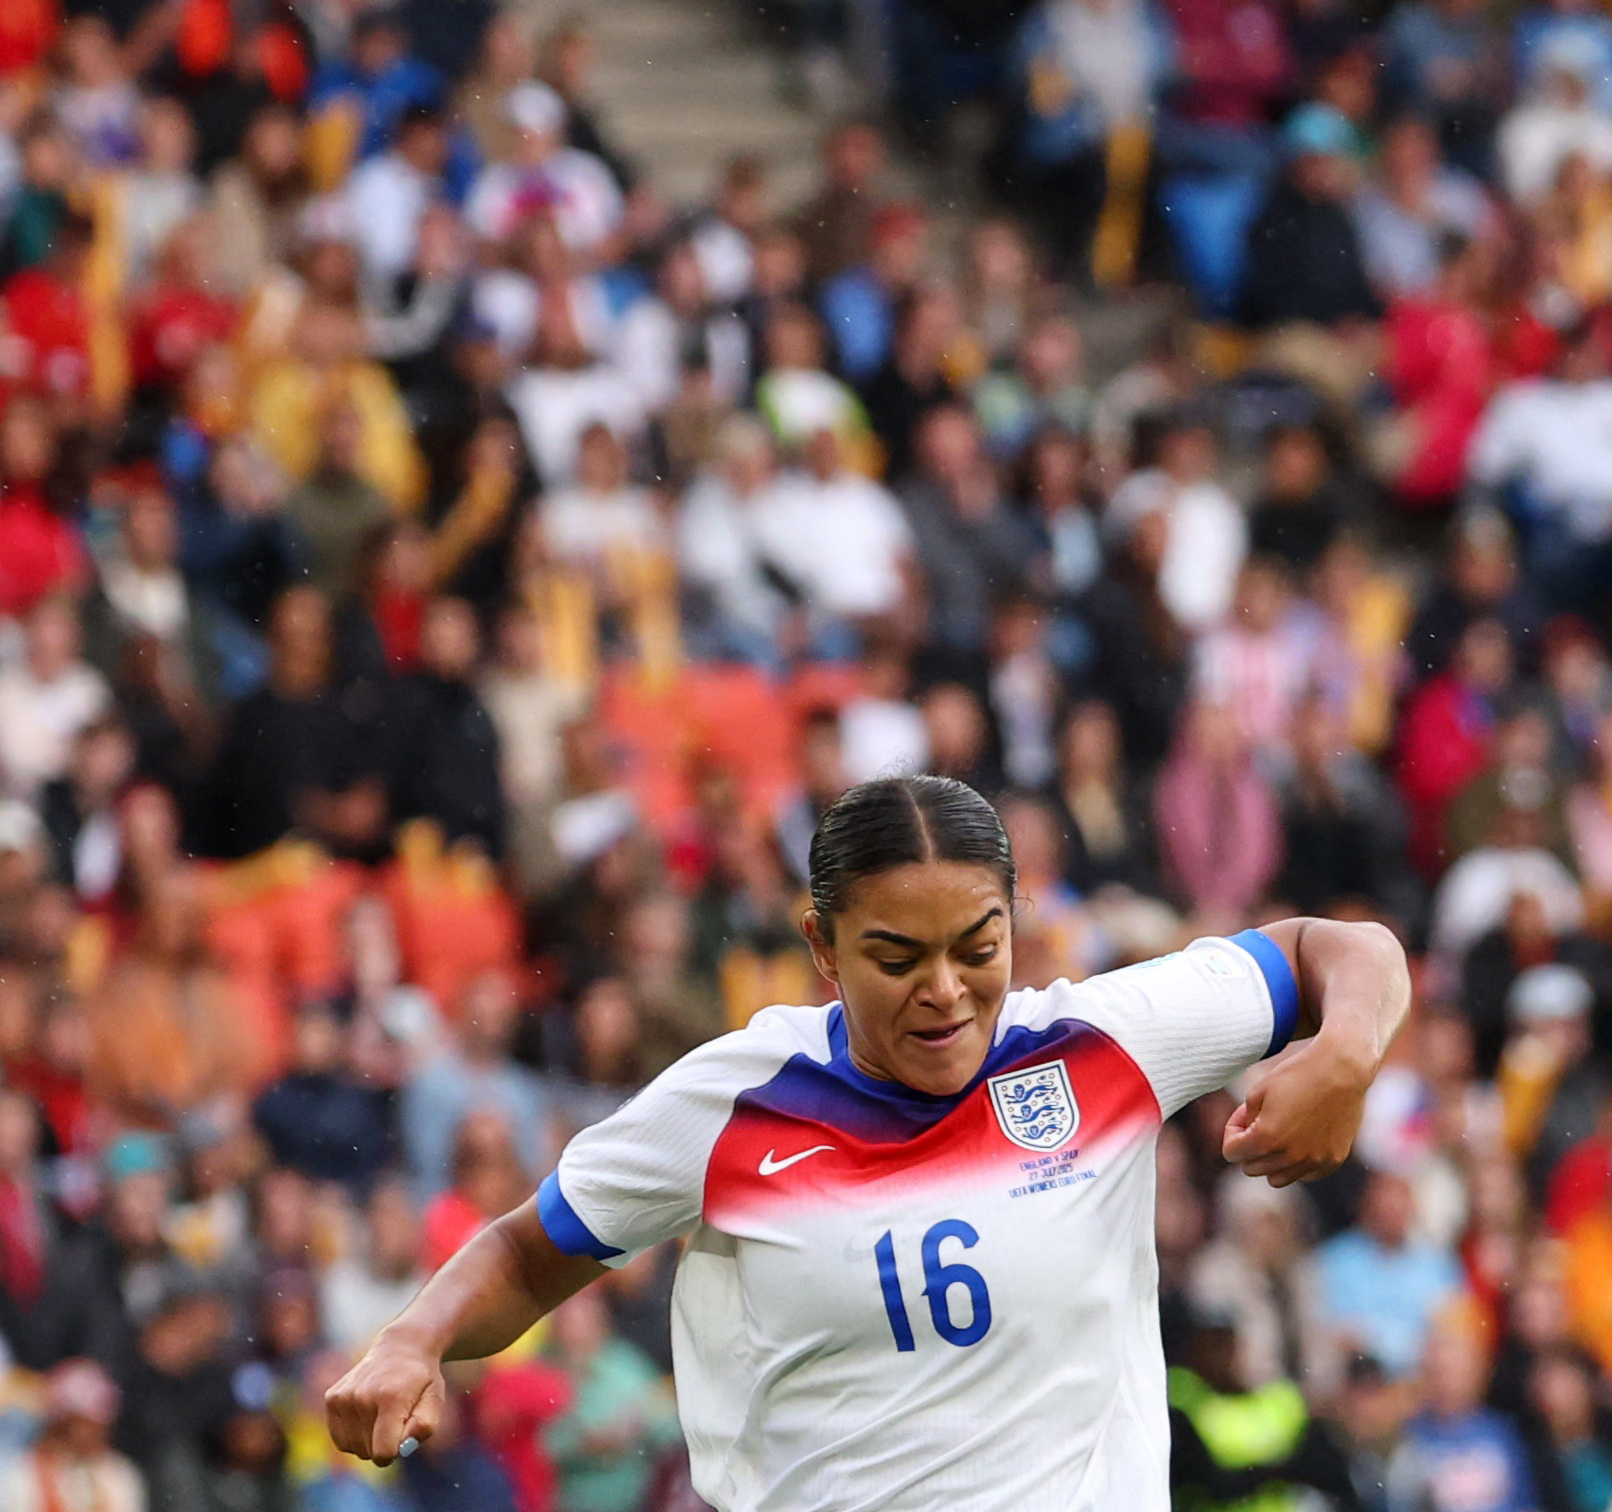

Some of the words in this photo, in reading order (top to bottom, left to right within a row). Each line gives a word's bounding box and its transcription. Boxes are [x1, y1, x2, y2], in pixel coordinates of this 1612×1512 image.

[1020, 1156, 1052, 1171] ENGLAND
[1061, 1149, 1079, 1161] SPAIN
[1009, 1186, 1029, 1198] UEFA
[1076, 1169, 1097, 1181] FINAL
[1029, 1172, 1038, 1181] 27
[1041, 1166, 1056, 1178] JULY
[874, 1219, 992, 1352] 16
